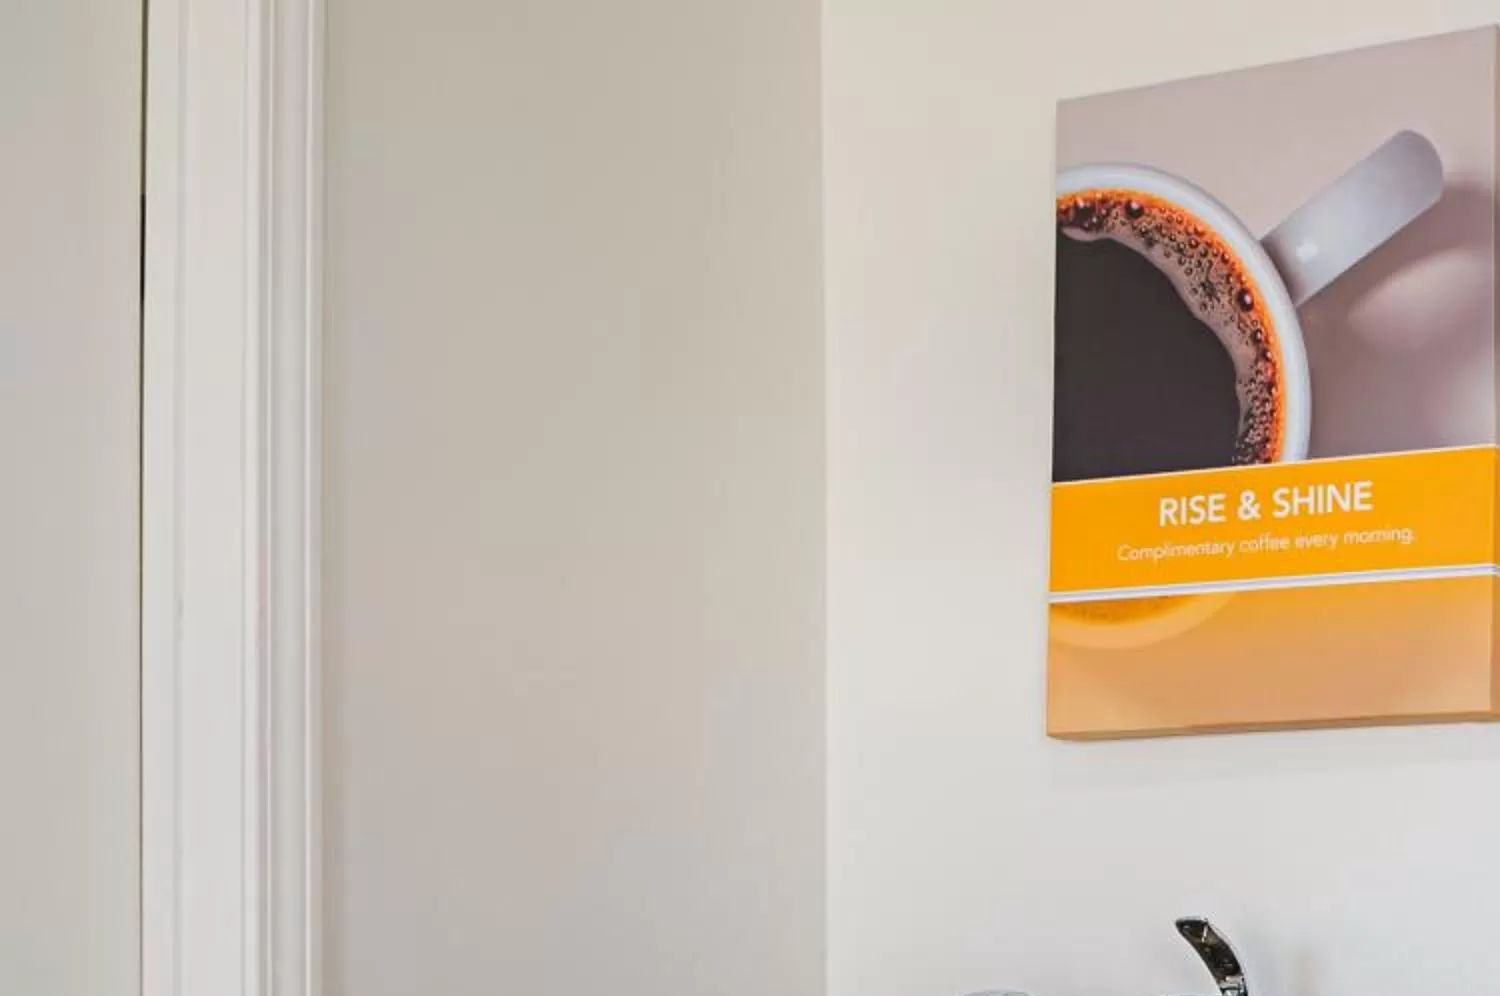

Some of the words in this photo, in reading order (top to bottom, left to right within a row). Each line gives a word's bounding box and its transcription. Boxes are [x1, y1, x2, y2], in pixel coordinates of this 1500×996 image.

[1158, 494, 1227, 527] RISE
[1238, 490, 1261, 521] &
[1272, 480, 1373, 517] SHINE
[1117, 541, 1235, 562] Complimentary
[1240, 536, 1290, 554] coffee
[1295, 534, 1338, 551] every
[1343, 526, 1415, 545] morning.
